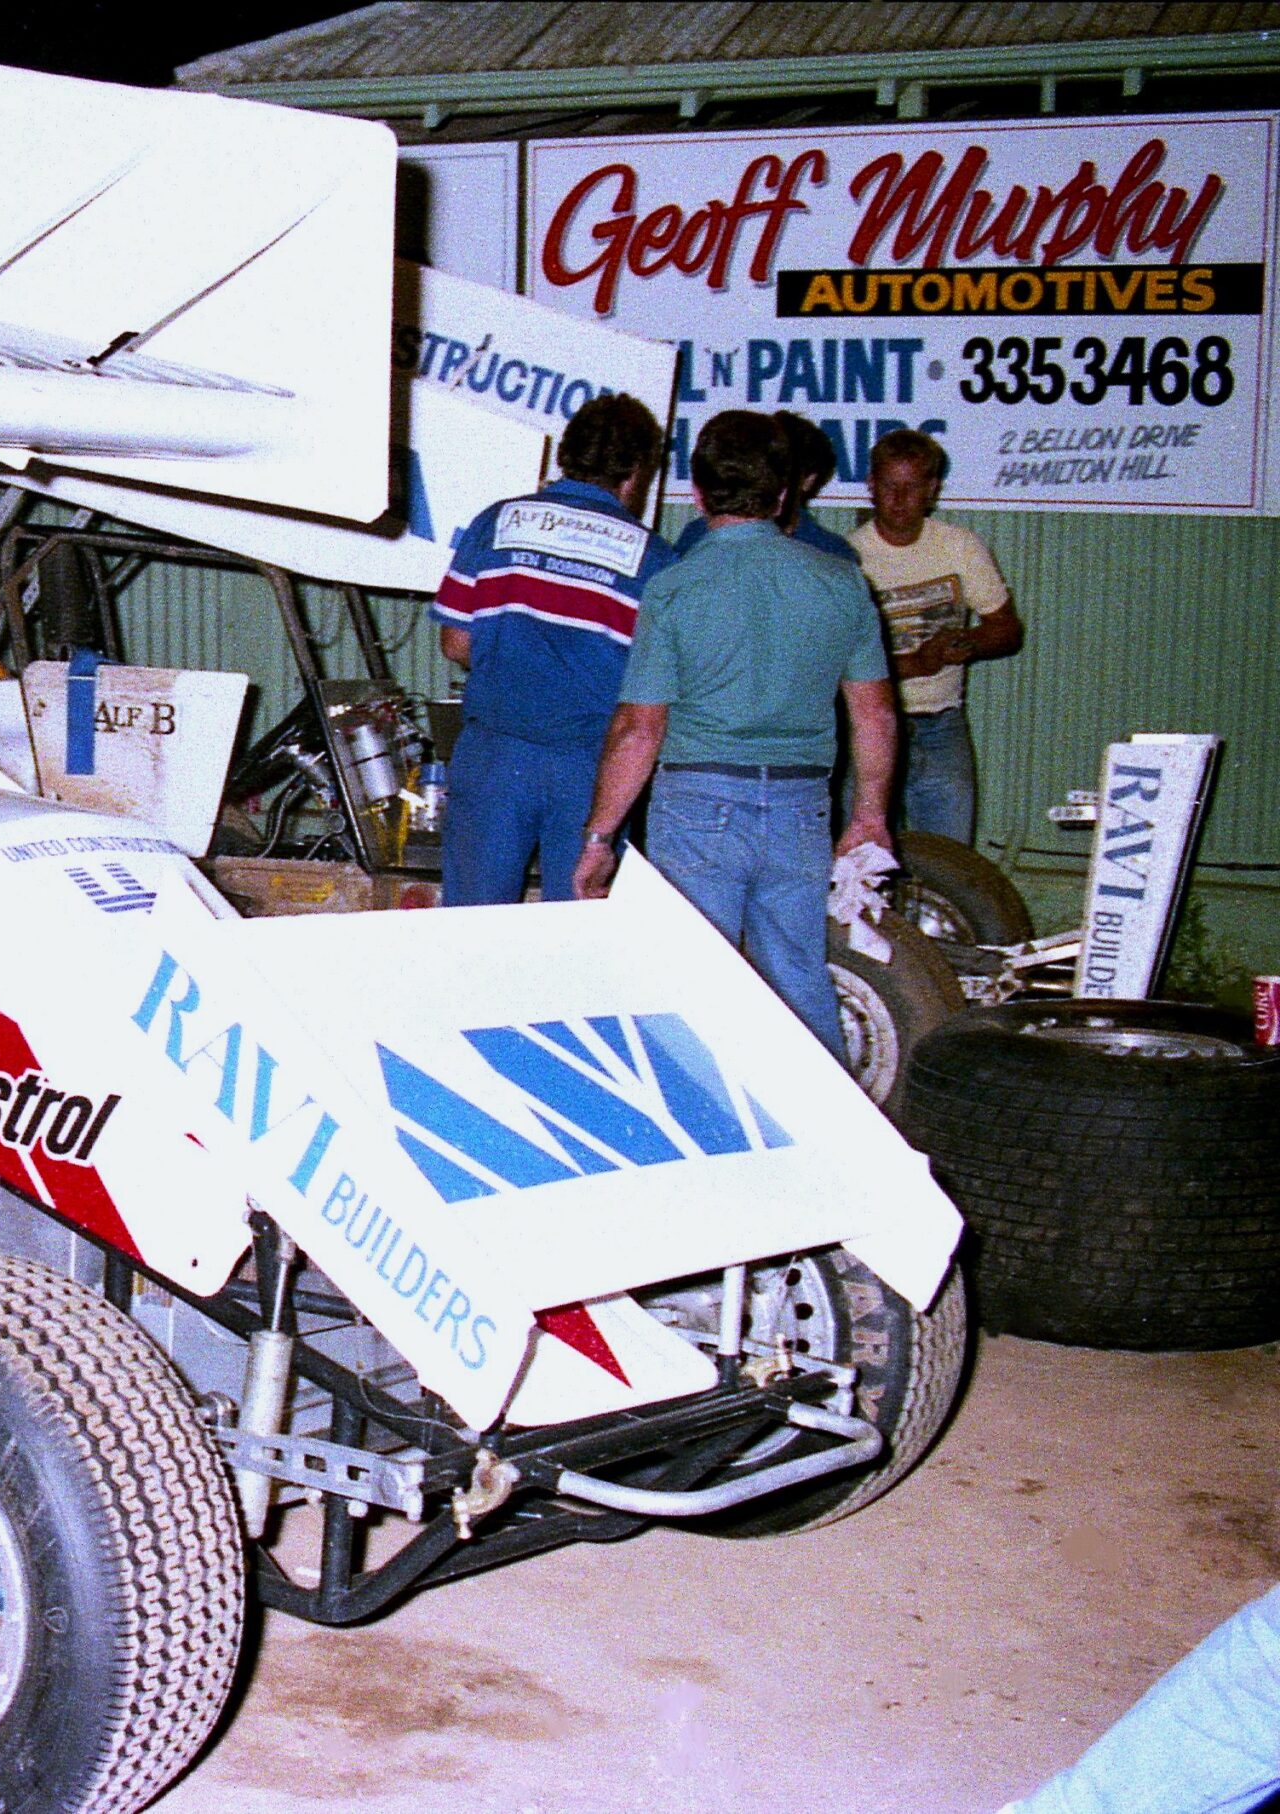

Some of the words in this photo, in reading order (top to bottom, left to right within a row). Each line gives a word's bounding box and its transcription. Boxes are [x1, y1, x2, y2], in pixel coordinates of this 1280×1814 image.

[542, 149, 828, 314] Geoff
[850, 138, 1228, 271] Murphy
[799, 268, 1217, 314] AUTOMOTIVES
[394, 326, 613, 421] STRUCTIO
[746, 338, 924, 403] PAINT
[994, 455, 1116, 487] HAMILTON
[999, 429, 1018, 454] 2
[1020, 425, 1125, 453] BELLION
[1129, 423, 1202, 450] DRIVE
[94, 700, 143, 734] ALF
[0, 839, 69, 862] UNITED
[1098, 763, 1162, 900] RAVI
[130, 949, 341, 1198] RAVI
[320, 1171, 497, 1371] BUILDERS
